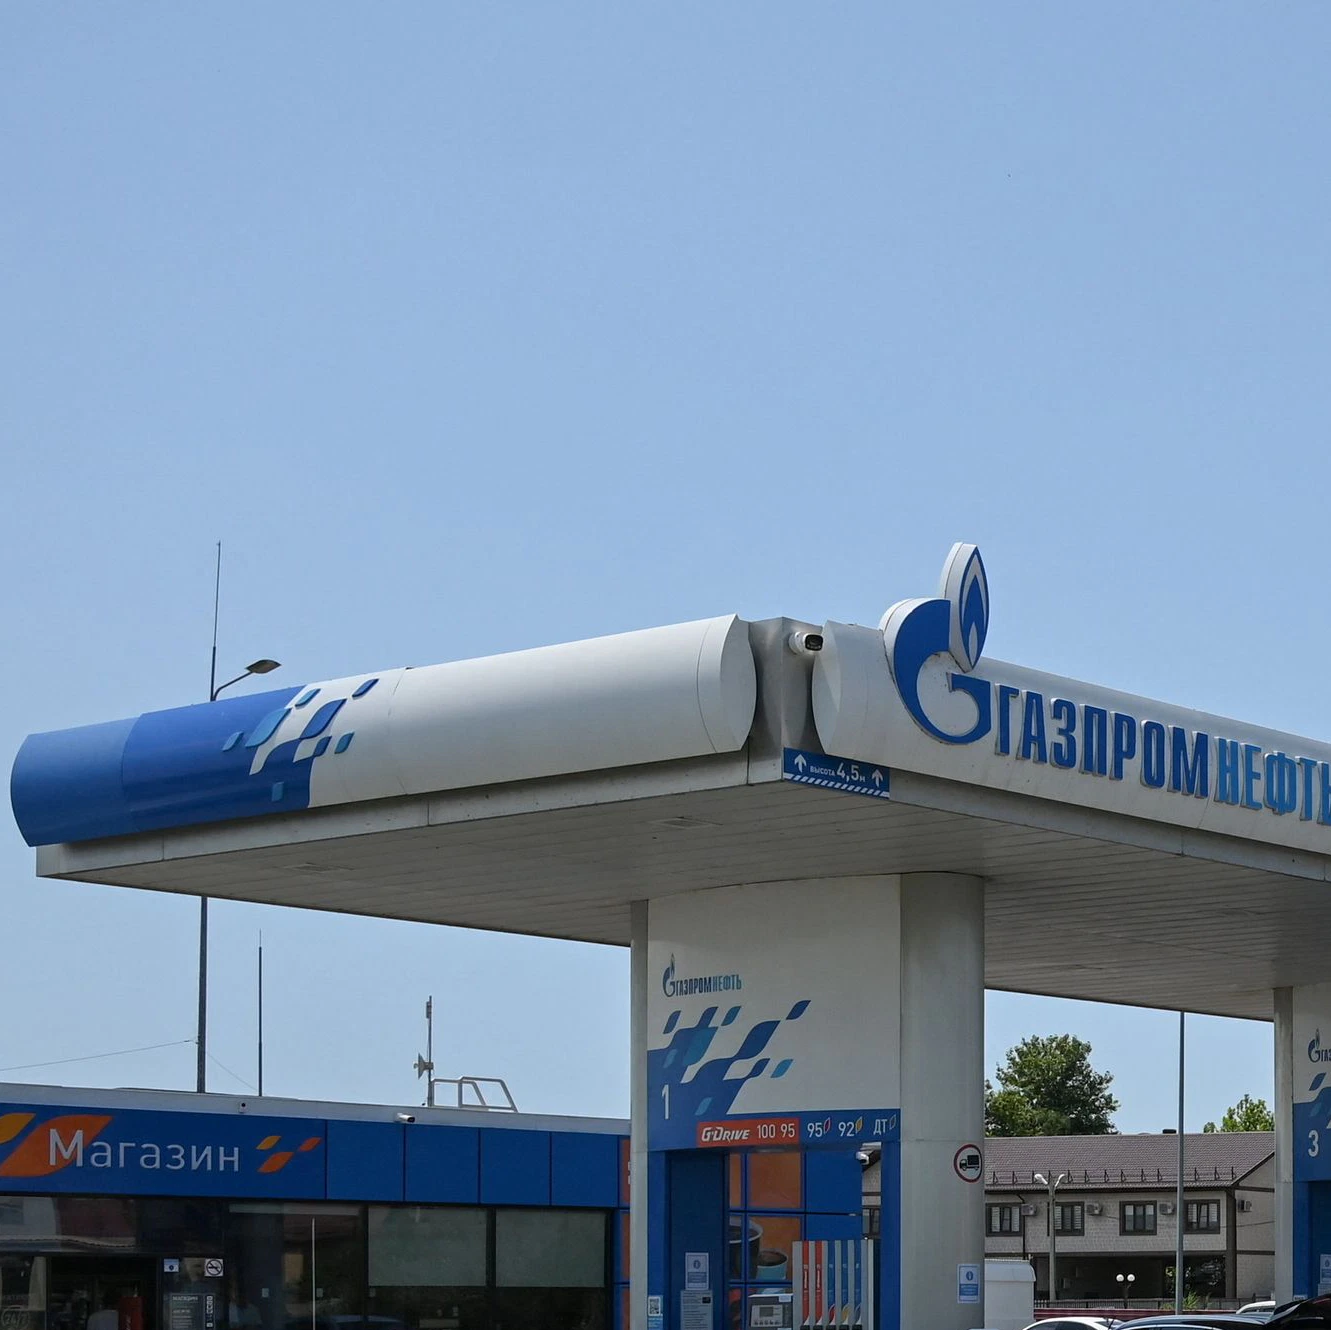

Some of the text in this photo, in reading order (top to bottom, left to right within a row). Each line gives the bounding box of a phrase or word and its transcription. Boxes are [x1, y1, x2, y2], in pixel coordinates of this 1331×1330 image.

[675, 974, 742, 996] ГАЗПРОМНЕФТЬ
[661, 1084, 670, 1120] 1
[757, 1123, 776, 1139] 100
[780, 1123, 796, 1138] 95
[807, 1122, 823, 1138] 95
[838, 1121, 855, 1137] 92
[873, 1119, 888, 1136] ДТ
[49, 1127, 239, 1172] Магазин
[1308, 1130, 1319, 1157] 3
